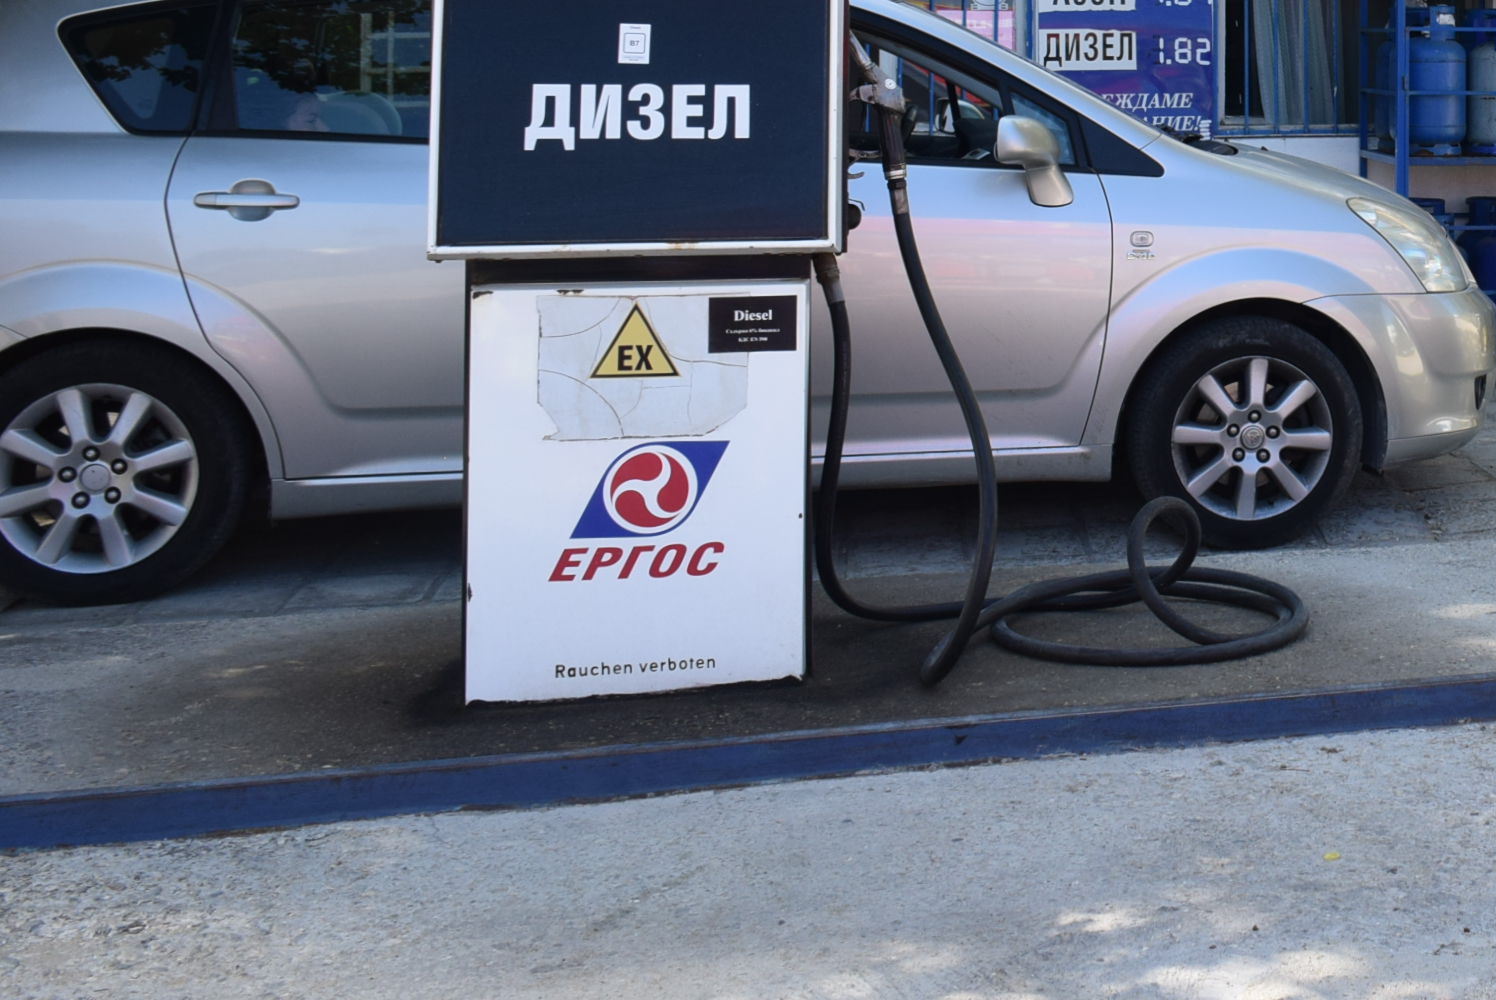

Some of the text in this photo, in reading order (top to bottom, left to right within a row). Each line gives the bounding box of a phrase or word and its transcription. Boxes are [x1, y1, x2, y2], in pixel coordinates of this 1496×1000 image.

[1043, 32, 1211, 68] ДИЗЕЛ 1.82
[1101, 92, 1194, 112] ЕЖДАМЕ
[523, 83, 751, 151] ДИЗЕЛ
[733, 309, 773, 322] Diesel
[617, 345, 653, 371] EX
[548, 541, 725, 582] ЕРГОС
[554, 656, 717, 679] Rauchen verboten
